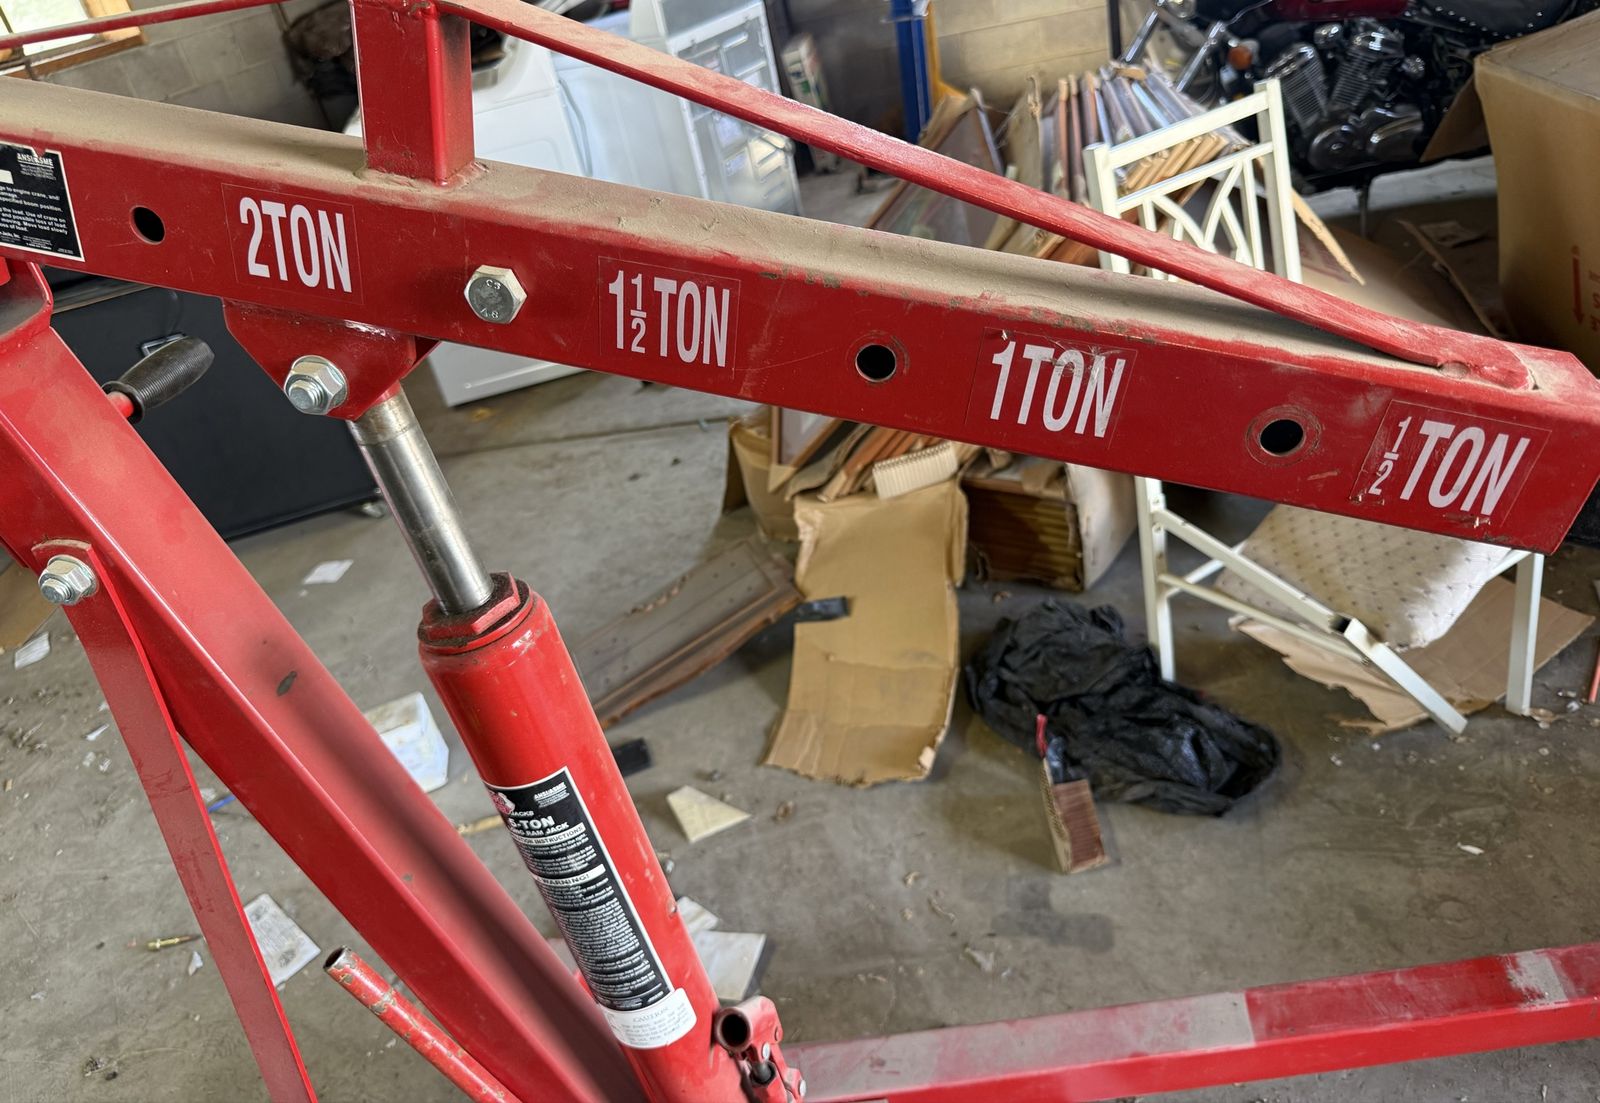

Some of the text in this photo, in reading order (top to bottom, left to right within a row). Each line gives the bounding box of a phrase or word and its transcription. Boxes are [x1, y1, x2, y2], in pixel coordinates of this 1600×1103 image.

[654, 277, 730, 367] TON
[1400, 420, 1531, 516] TON
[545, 822, 570, 837] JACK
